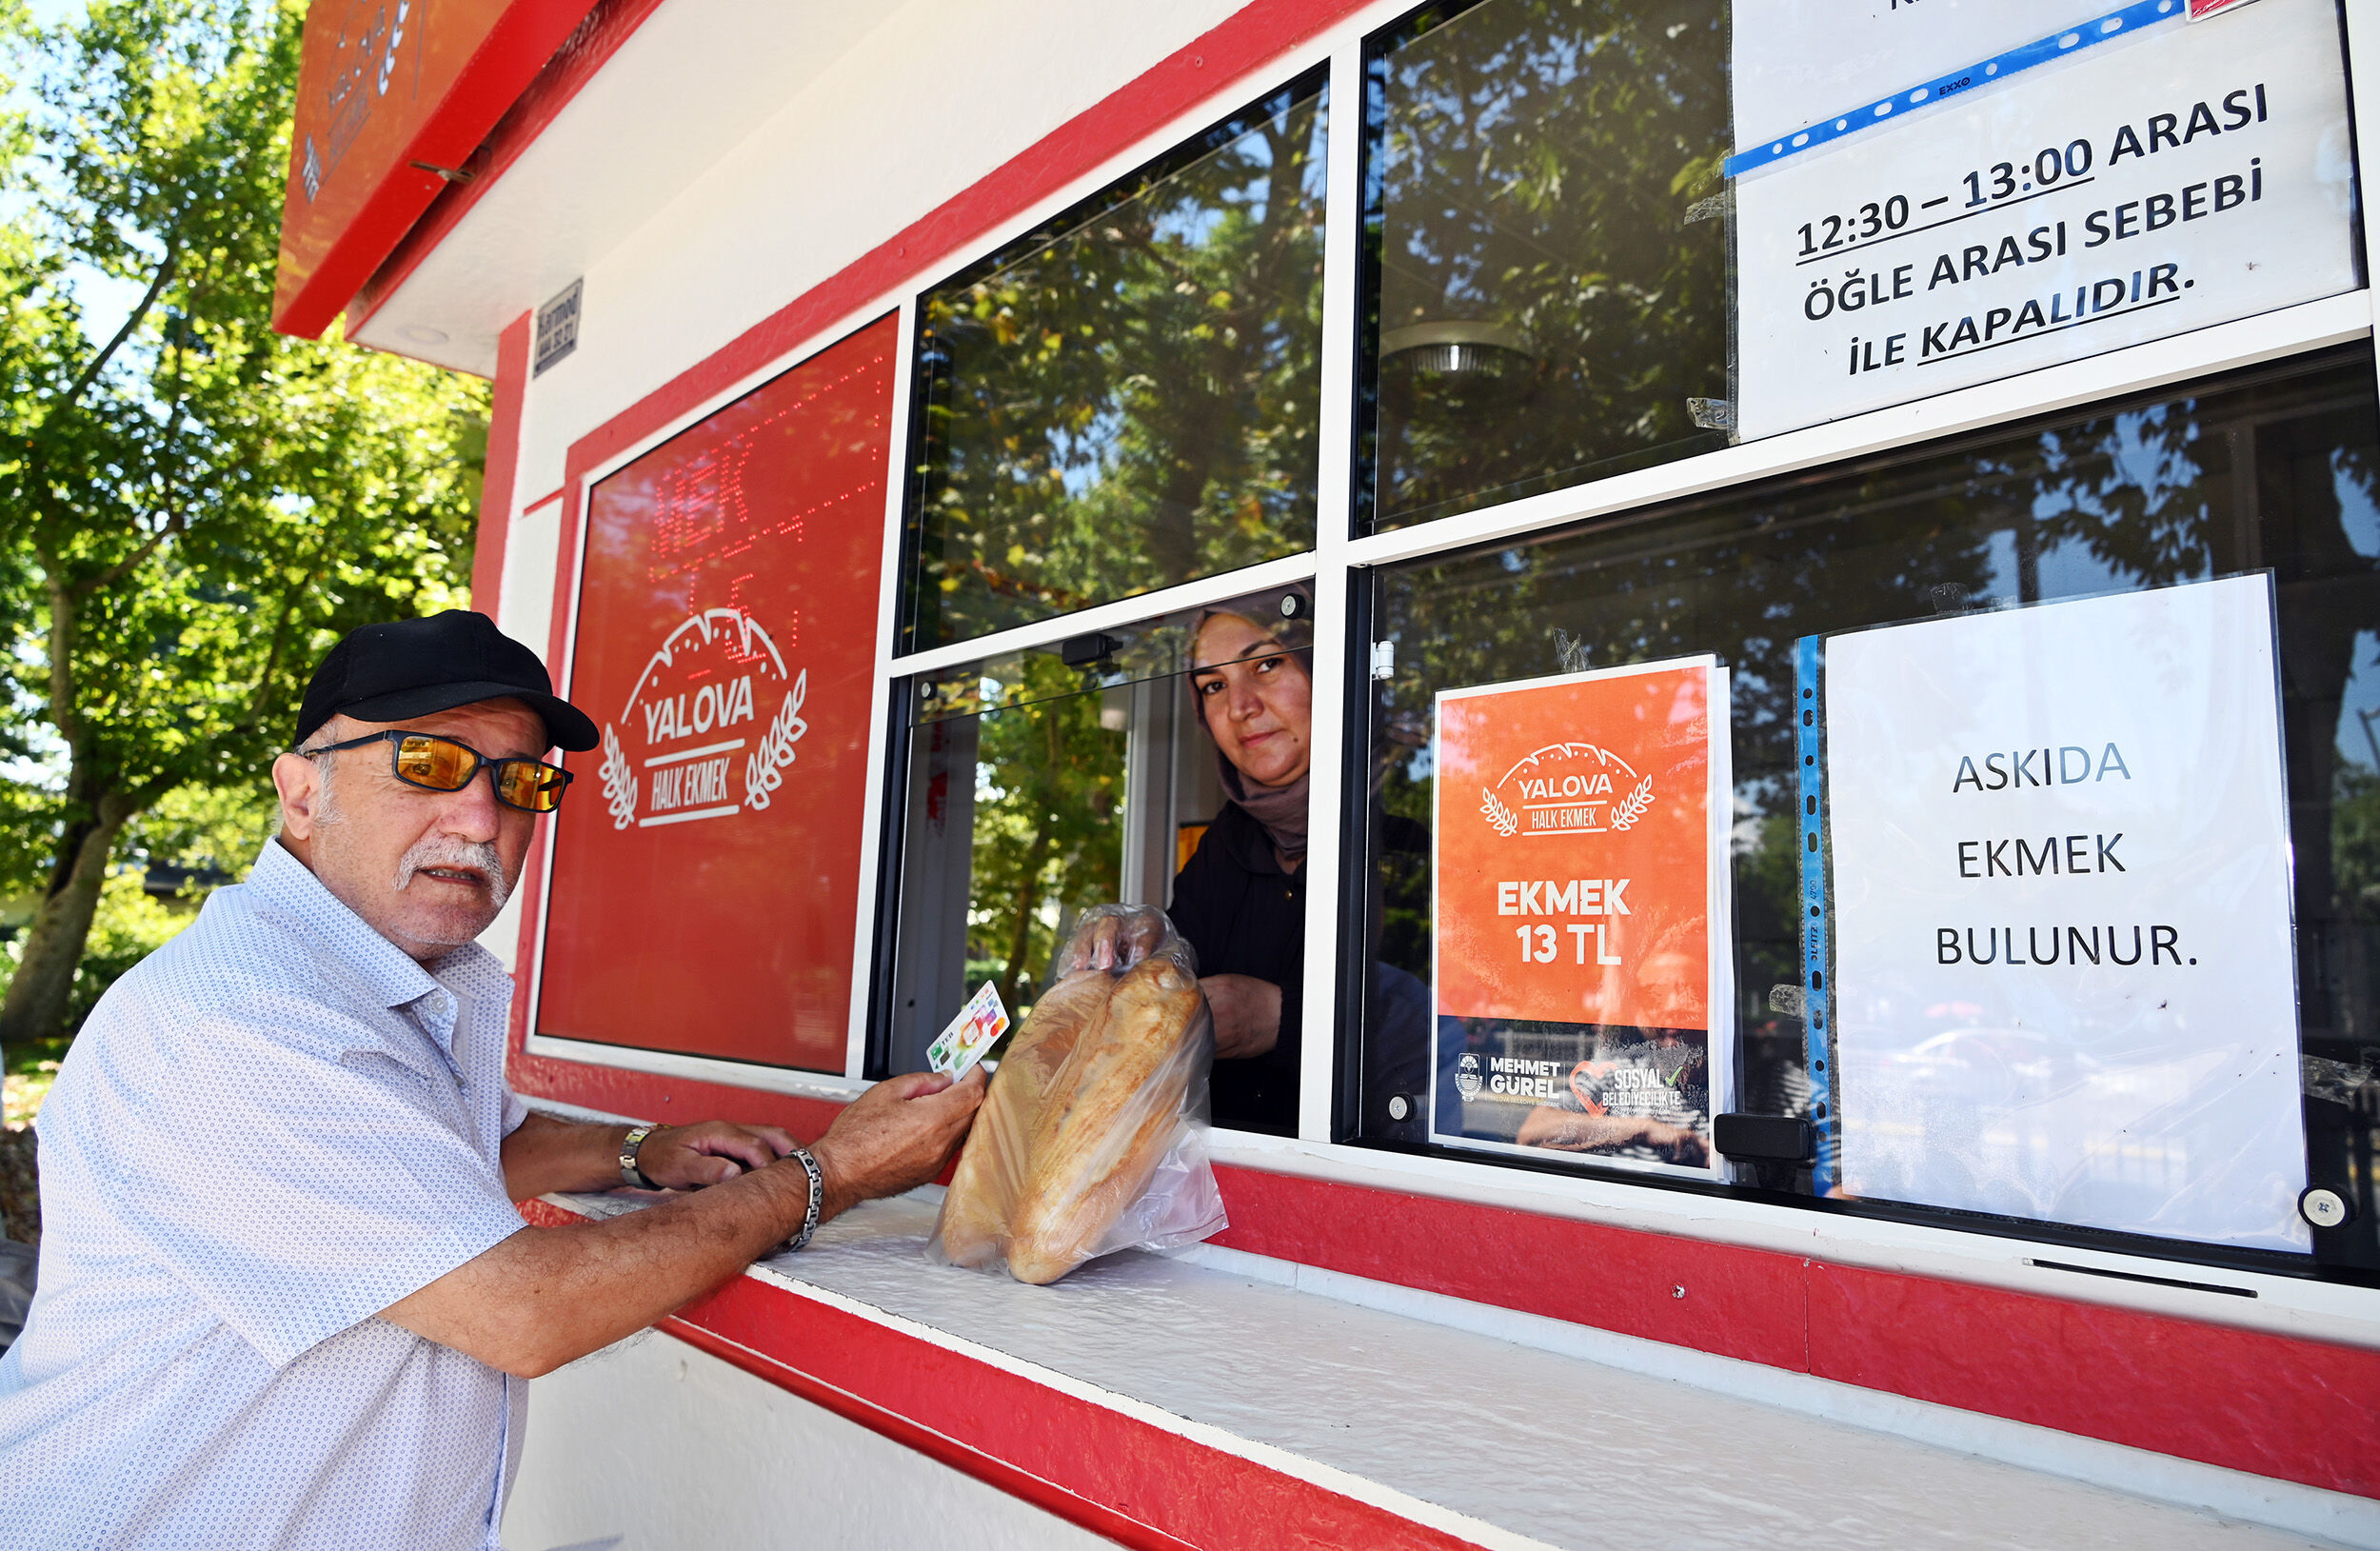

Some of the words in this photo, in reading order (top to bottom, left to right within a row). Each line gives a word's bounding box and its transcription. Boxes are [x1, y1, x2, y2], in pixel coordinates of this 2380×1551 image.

[1796, 193, 1911, 259] 12:30
[1963, 138, 2094, 209] 13:00
[2108, 83, 2269, 167] ARASI
[1804, 264, 1914, 321] ÖĞLE
[1927, 220, 2067, 291] ARASI
[2084, 156, 2263, 249] SEBEBİ
[1849, 331, 1907, 376] İLE
[1920, 262, 2195, 359] KAPALIDIR.
[644, 674, 755, 746] YALOVA
[650, 766, 684, 811] HALK
[684, 757, 731, 806] EKMEK
[1518, 773, 1614, 800] YALOVA
[1953, 742, 2132, 793] ASKIDA
[1532, 809, 1558, 829] HALK
[1560, 807, 1597, 827] EKMEK
[1957, 833, 2127, 878] EKMEK
[1497, 879, 1632, 916] EKMEK
[1516, 924, 1557, 964] 13
[1566, 924, 1622, 964] TL
[1936, 925, 2198, 965] BULUNUR.
[1490, 1056, 1561, 1078] MEHMET
[1490, 1074, 1560, 1099] GÜREL
[1614, 1067, 1665, 1089] SOSYAL
